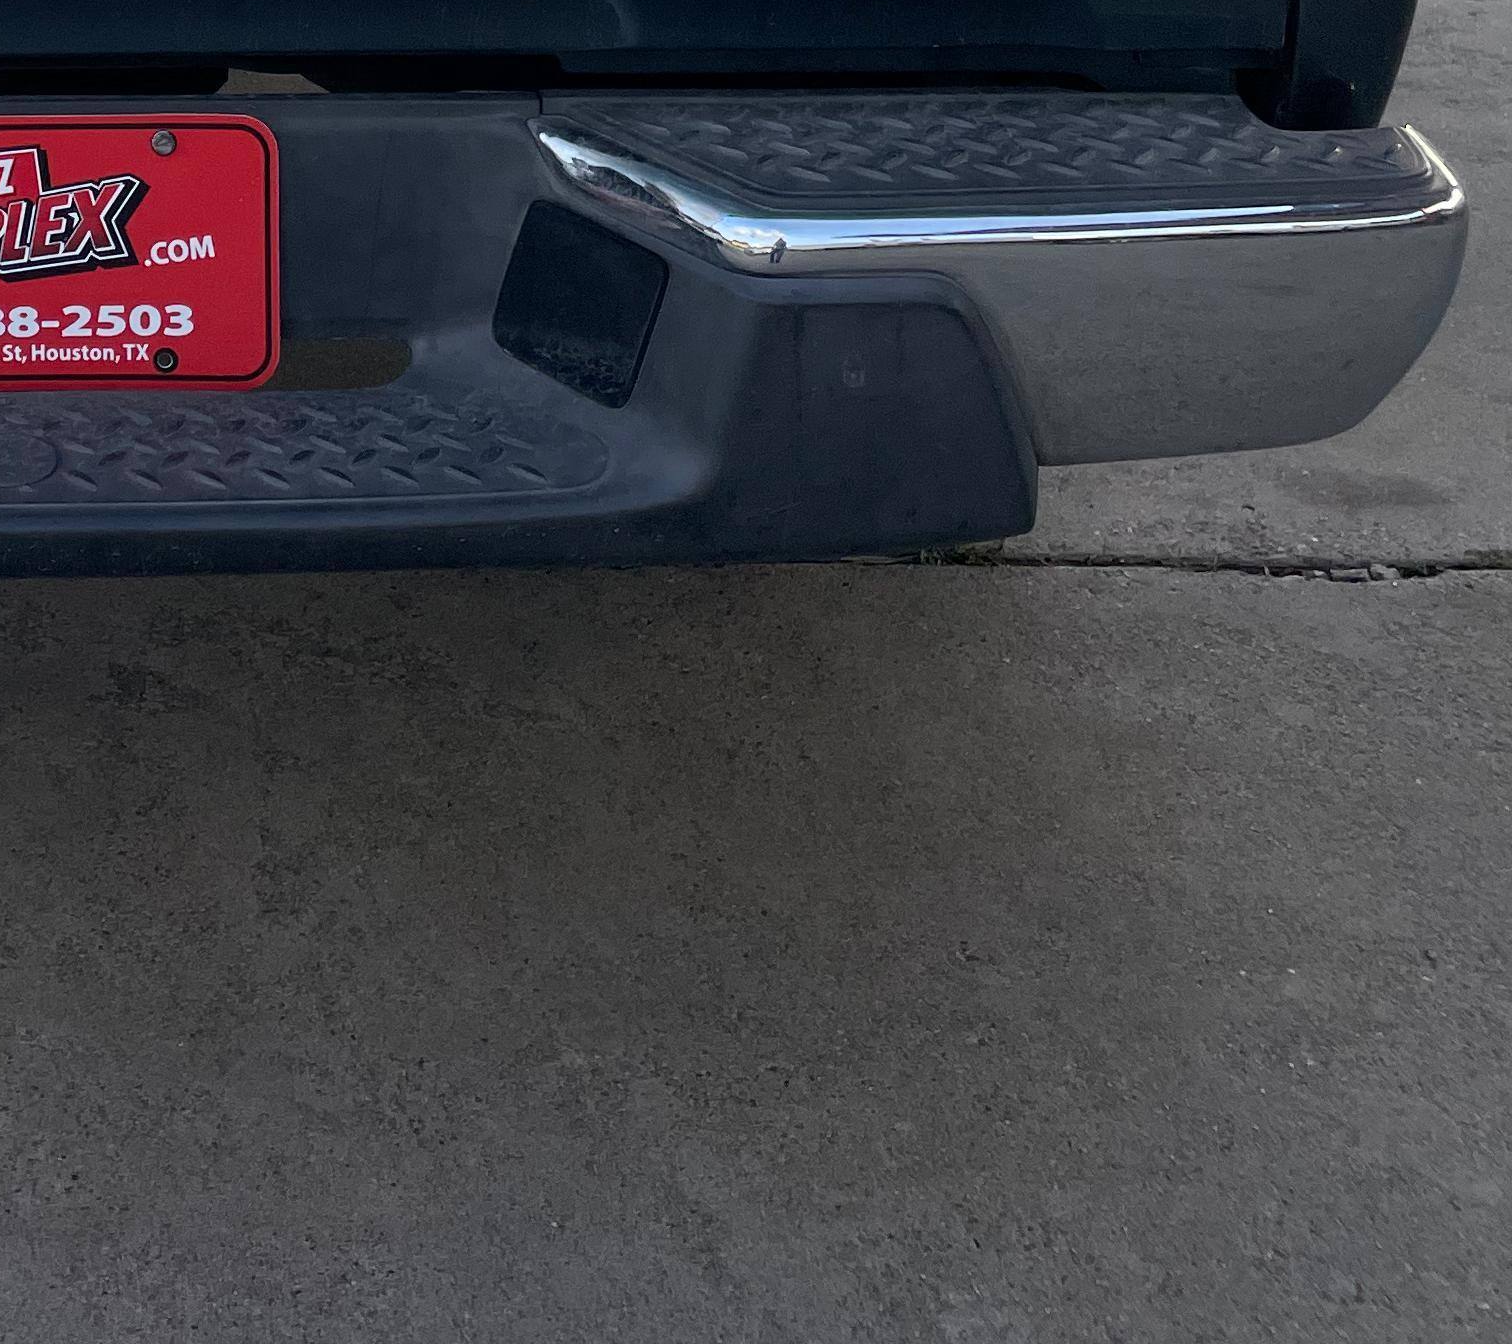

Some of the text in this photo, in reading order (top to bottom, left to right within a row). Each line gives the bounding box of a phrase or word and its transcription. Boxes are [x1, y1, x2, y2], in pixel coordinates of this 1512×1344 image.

[2, 345, 27, 365] St,
[31, 344, 120, 364] Houston,
[122, 344, 150, 361] TX
